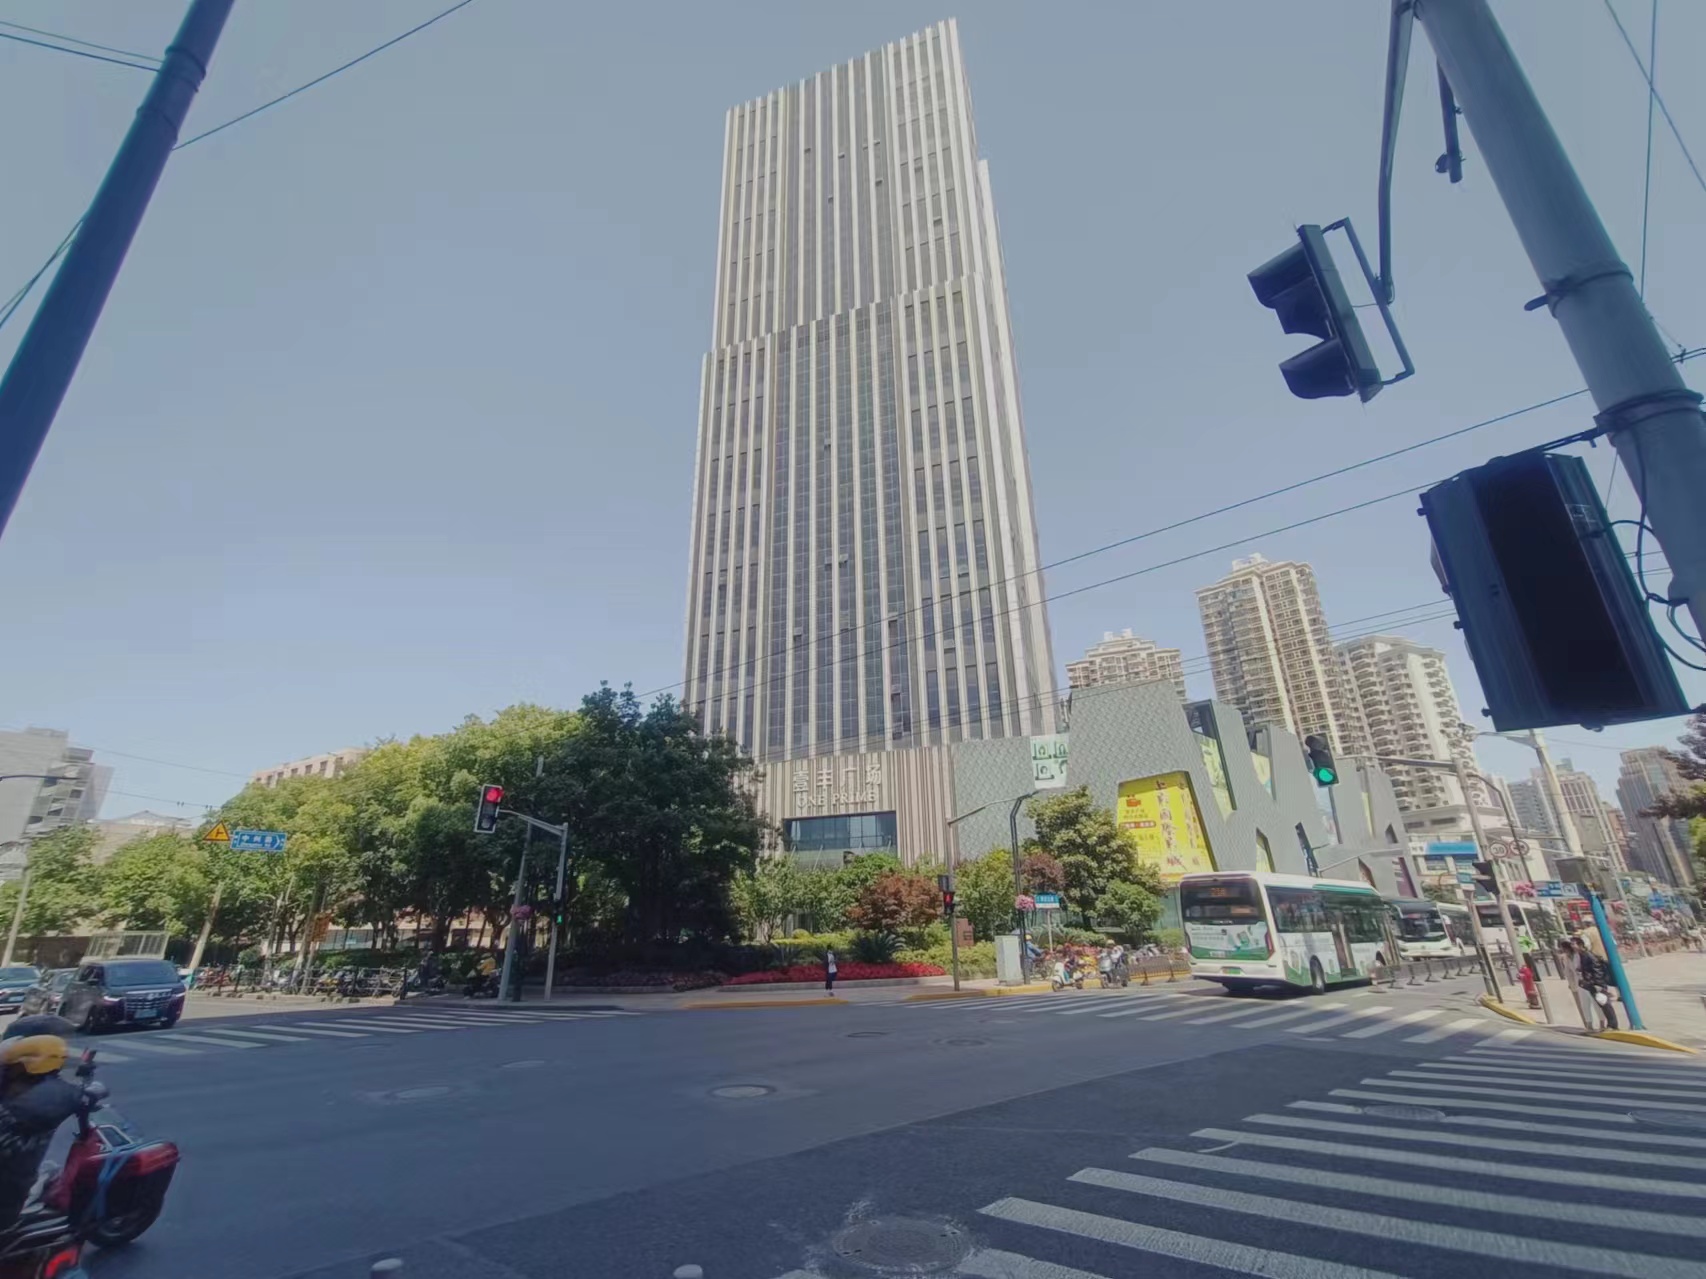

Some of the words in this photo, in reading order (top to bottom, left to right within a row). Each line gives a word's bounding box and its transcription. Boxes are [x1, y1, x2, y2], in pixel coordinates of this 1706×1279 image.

[793, 764, 881, 792] 壹丰广场
[797, 794, 826, 808] ONE
[831, 790, 876, 806] PRIME
